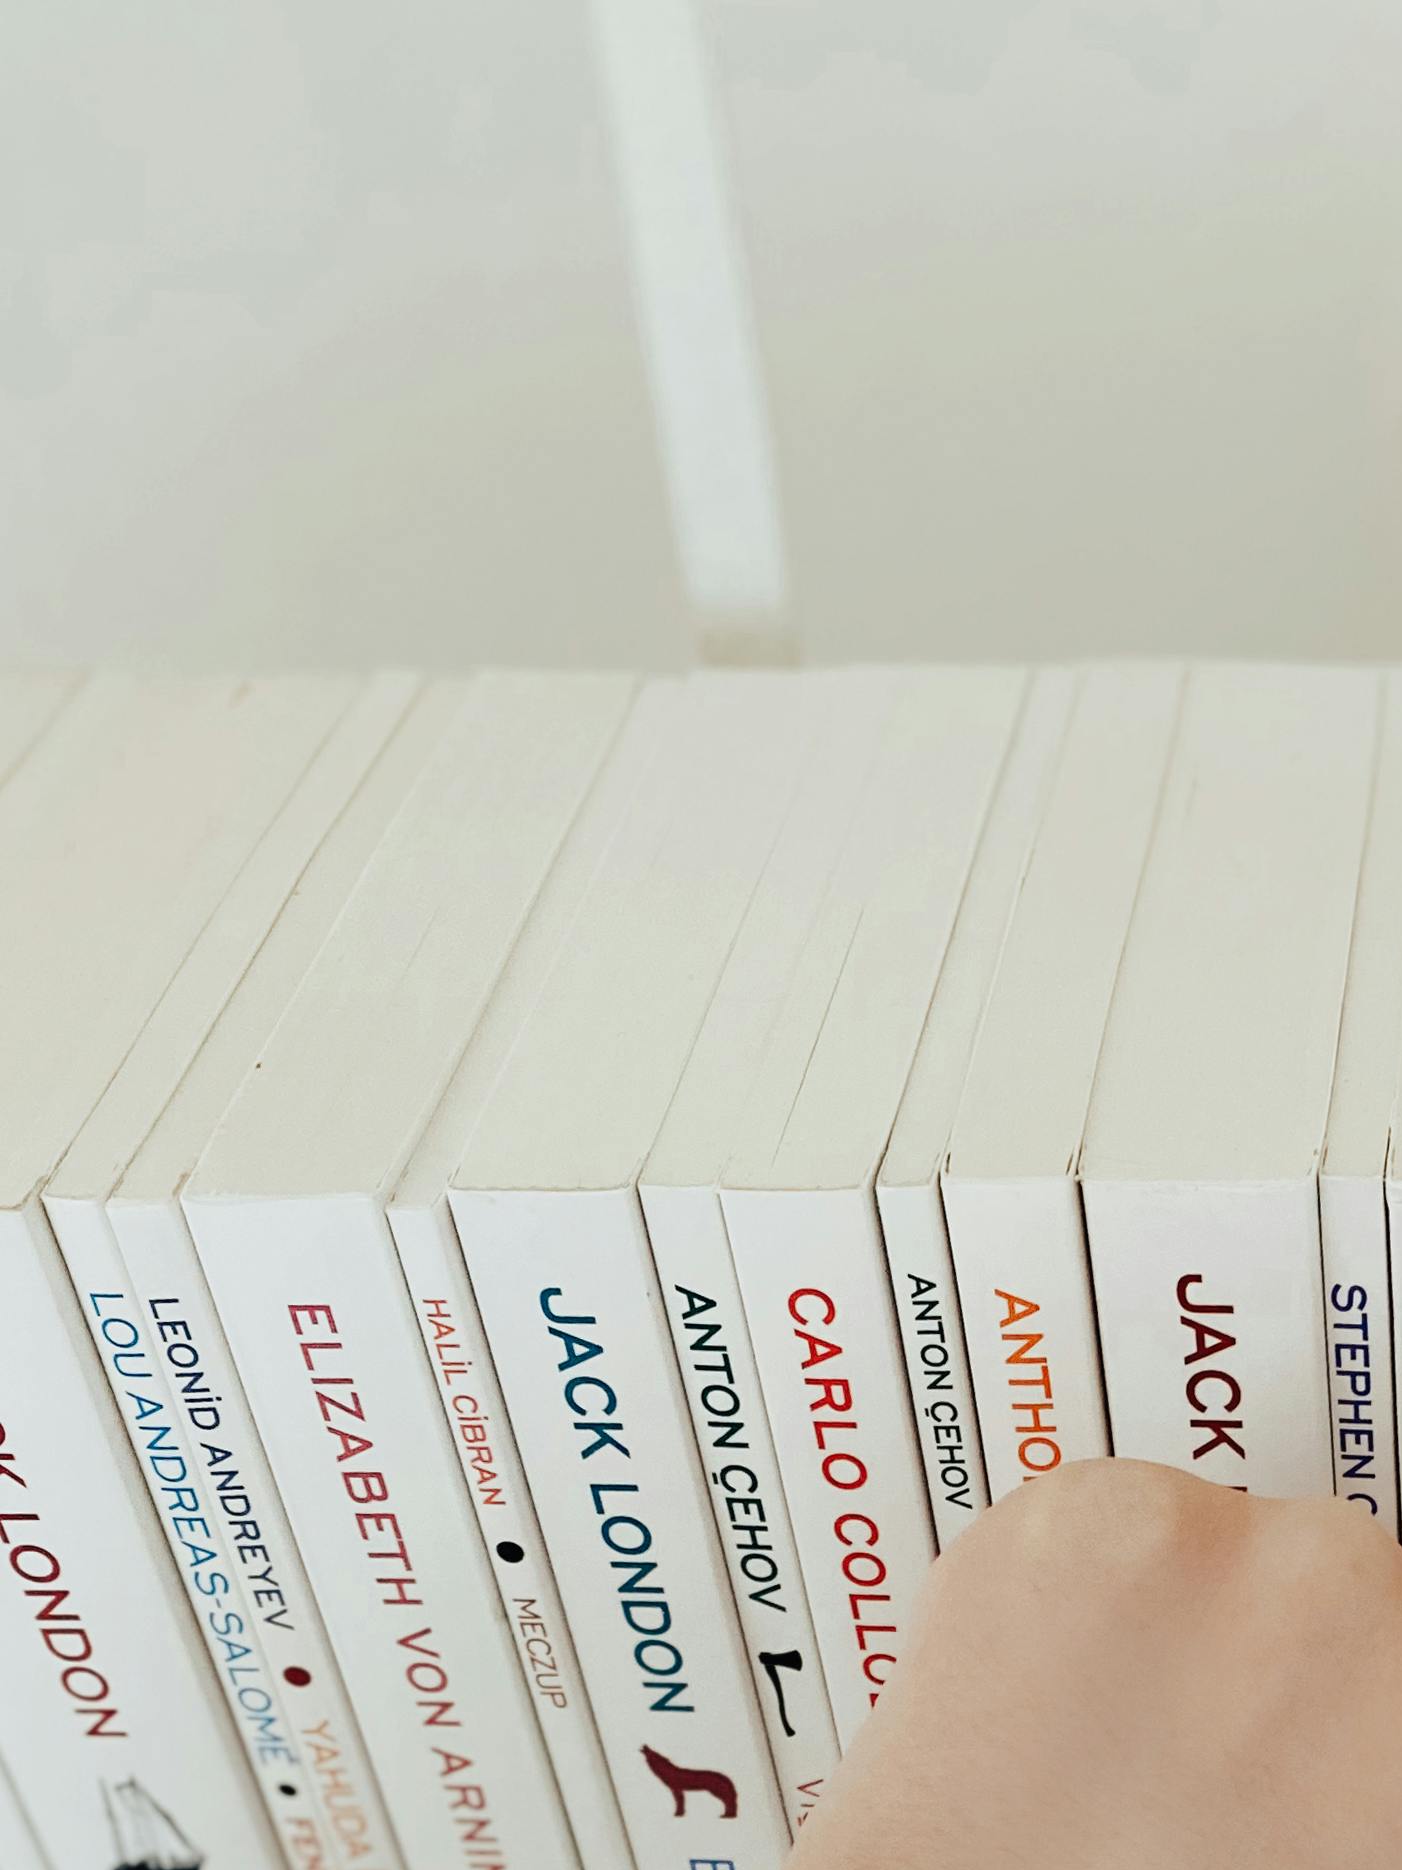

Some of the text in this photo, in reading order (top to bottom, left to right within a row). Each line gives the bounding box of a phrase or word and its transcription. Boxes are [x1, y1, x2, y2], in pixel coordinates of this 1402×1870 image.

[89, 1293, 153, 1379] LOU
[149, 1298, 221, 1431] LEONİD
[200, 1443, 295, 1632] ANDREYEV
[674, 1284, 787, 1613] ANTON ÇEHOV
[907, 1273, 973, 1510] ANTON ÇEHOV
[994, 1288, 1062, 1482] ANTHO
[1176, 1273, 1248, 1461] JACK
[1331, 1283, 1377, 1481] STEPHEN
[0, 1513, 128, 1737] LONDON
[287, 1304, 423, 1606] ELIZABETH
[396, 1628, 462, 1727] VON
[422, 1298, 568, 1709] HALİL CİBRAN MECZUP
[539, 1287, 632, 1461] JACK
[589, 1483, 695, 1712] LONDON
[787, 1287, 897, 1708] CARLO COLLO
